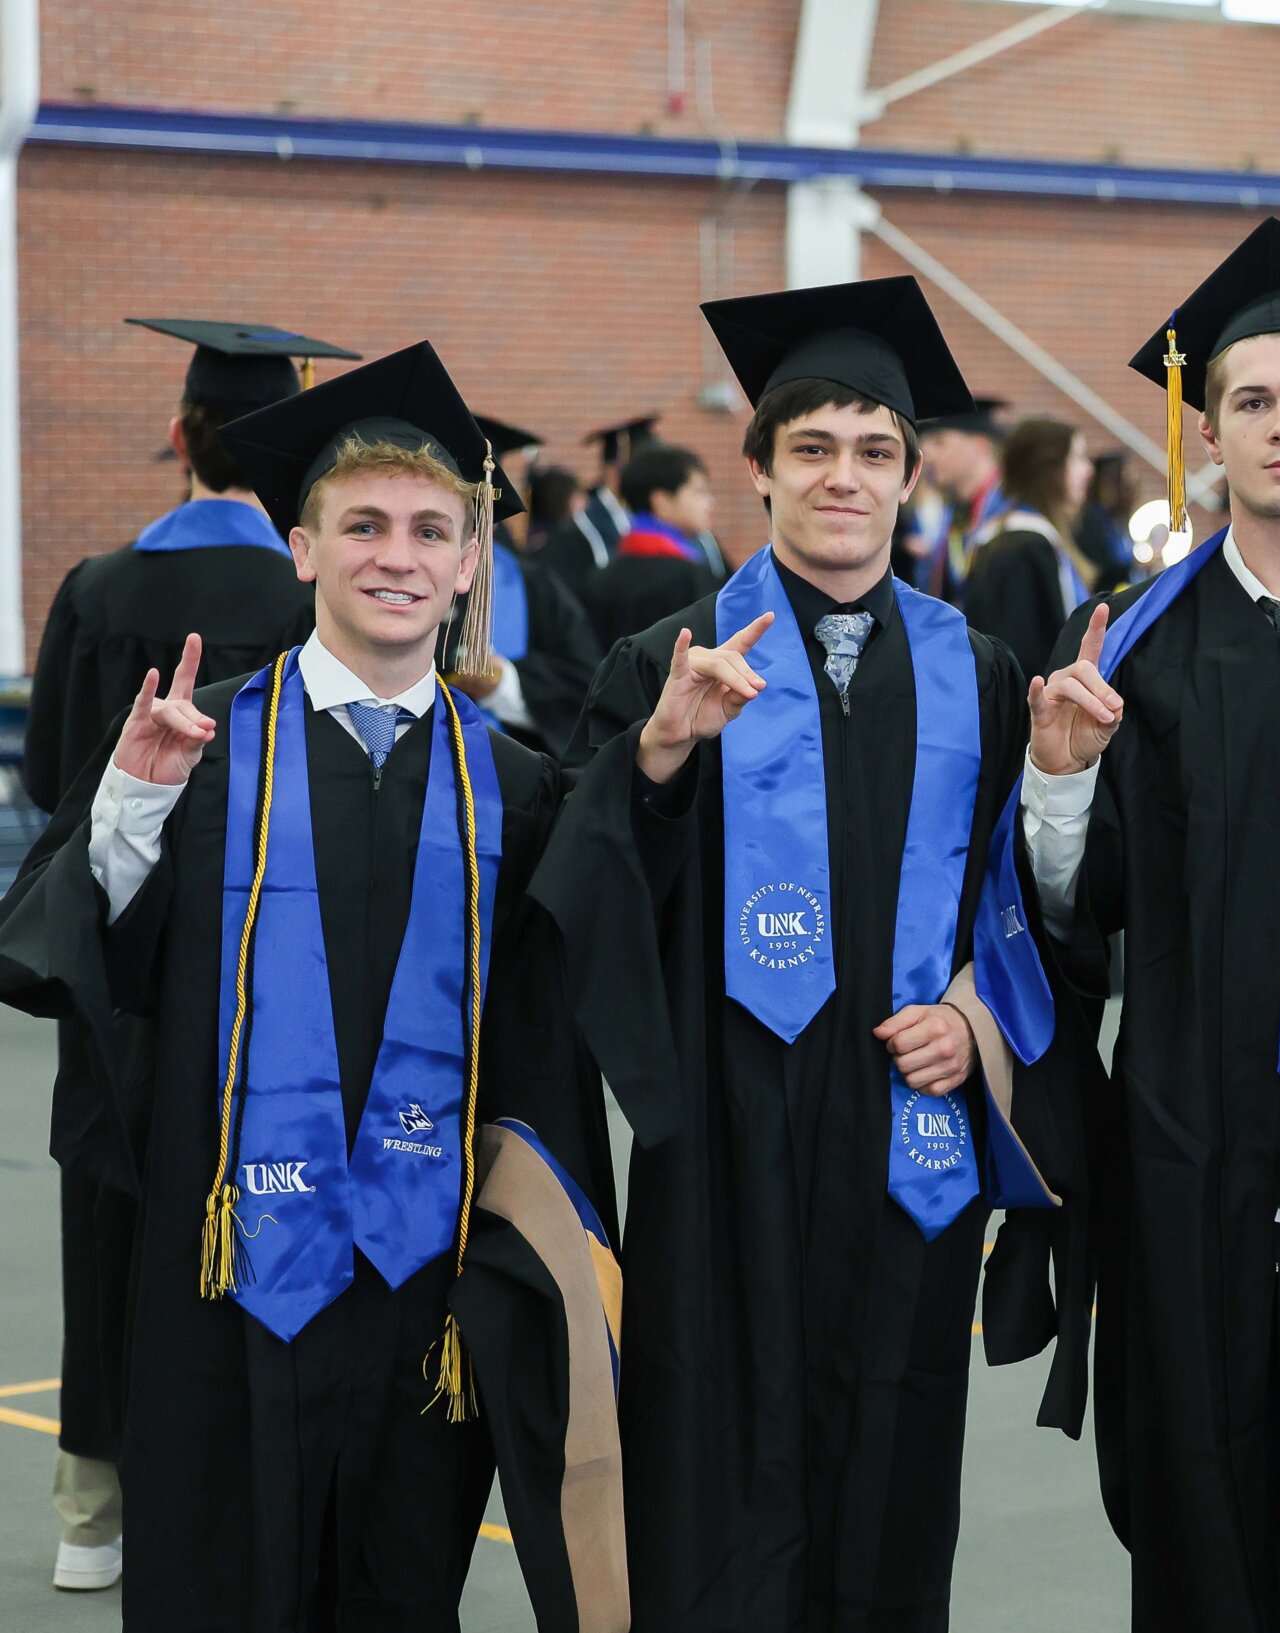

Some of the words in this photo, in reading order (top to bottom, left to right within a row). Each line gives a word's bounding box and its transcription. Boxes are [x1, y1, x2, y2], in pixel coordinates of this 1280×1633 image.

[740, 884, 775, 945] UNIVERSITY
[779, 882, 795, 891] OF
[797, 886, 825, 943] NEBRASKA
[769, 941, 797, 951] 1905
[749, 945, 815, 969] KEARNEY
[382, 1138, 442, 1158] WRESTLING
[927, 1142, 950, 1151] 1905
[908, 1148, 962, 1170] KEARNEY
